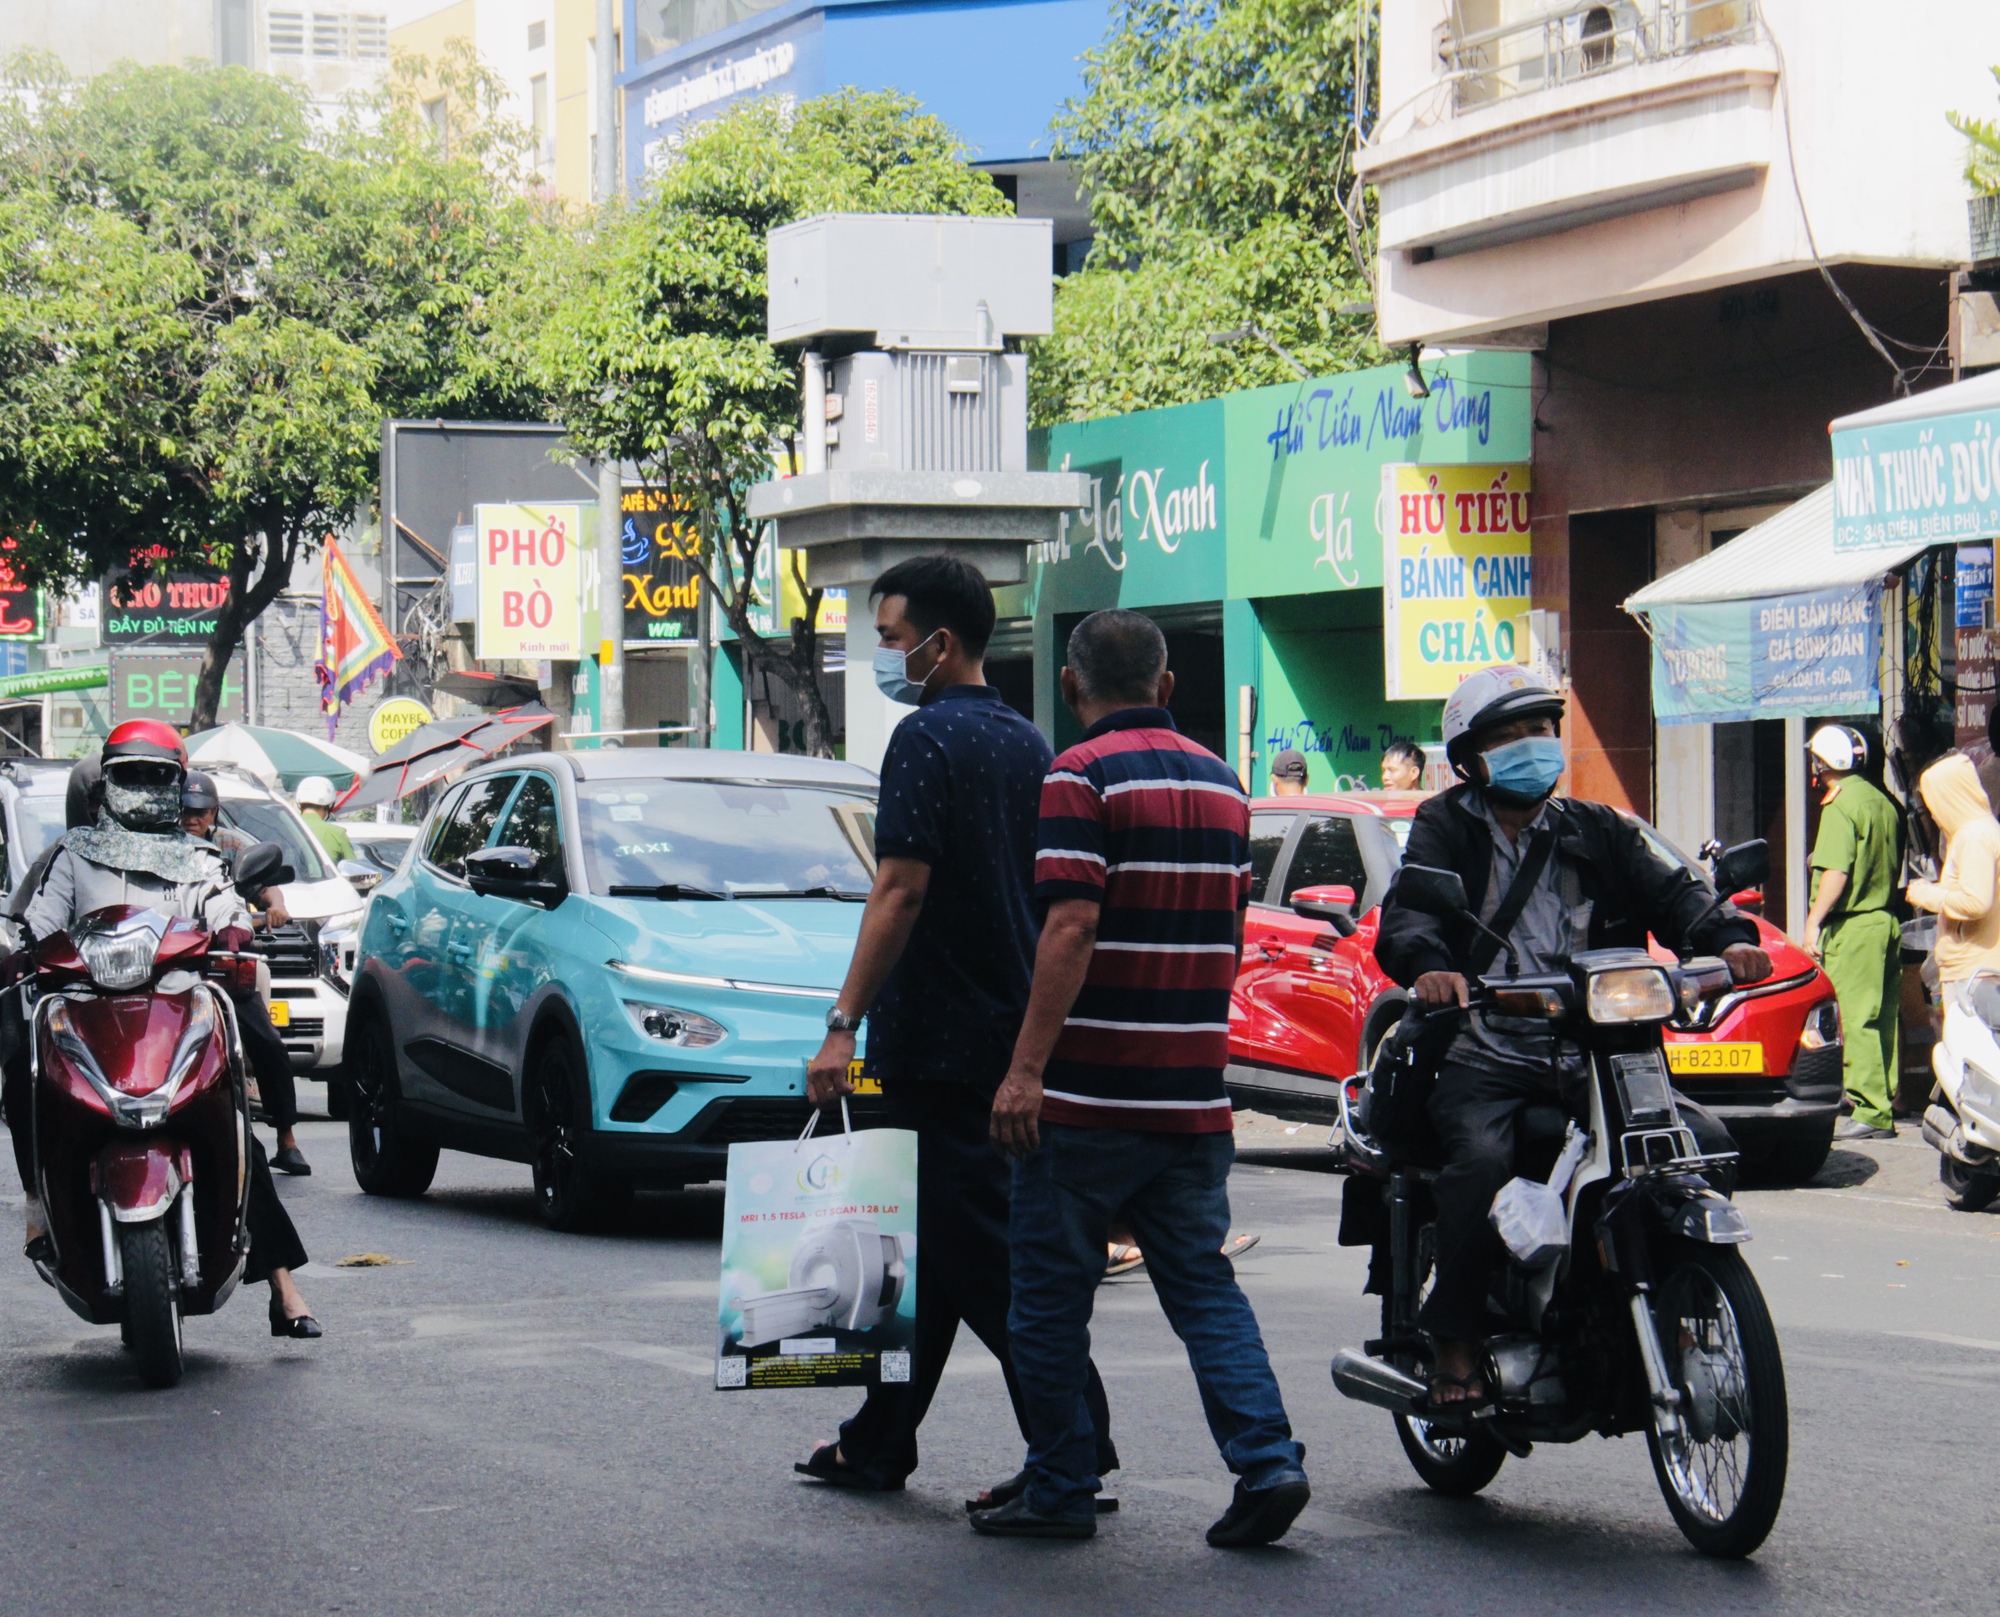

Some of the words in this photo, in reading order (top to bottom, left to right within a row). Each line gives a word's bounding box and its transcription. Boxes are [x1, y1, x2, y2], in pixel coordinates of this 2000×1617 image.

[1268, 403, 1304, 462] Hủ
[1366, 386, 1422, 452] Nam
[1836, 437, 1877, 518] NHÀ
[1879, 427, 1947, 513] THUỐC
[1130, 459, 1217, 554] Xanh
[1400, 474, 1446, 535] HỦ
[1455, 471, 1531, 535] TIẾU
[1887, 515, 1918, 542] ĐIỆN
[1921, 512, 1951, 537] BIÊN
[488, 514, 566, 567] PHỞ
[1309, 491, 1360, 588] Lá
[1401, 546, 1465, 599] BÁNH
[1473, 555, 1531, 598] CANH
[109, 615, 140, 633] ĐẦY
[143, 616, 164, 633] ĐỦ
[503, 579, 553, 629] BÒ
[1798, 599, 1829, 629] BÁN
[1420, 609, 1515, 662] CHÁO
[1830, 627, 1864, 657] DÂN
[619, 842, 671, 856] TAXI
[741, 1214, 759, 1223] MRI
[762, 1213, 777, 1221] 1.5
[780, 1211, 806, 1220] TESLA
[830, 1205, 857, 1216] SCAN
[861, 1205, 879, 1213] 128
[882, 1205, 899, 1214] LAT
